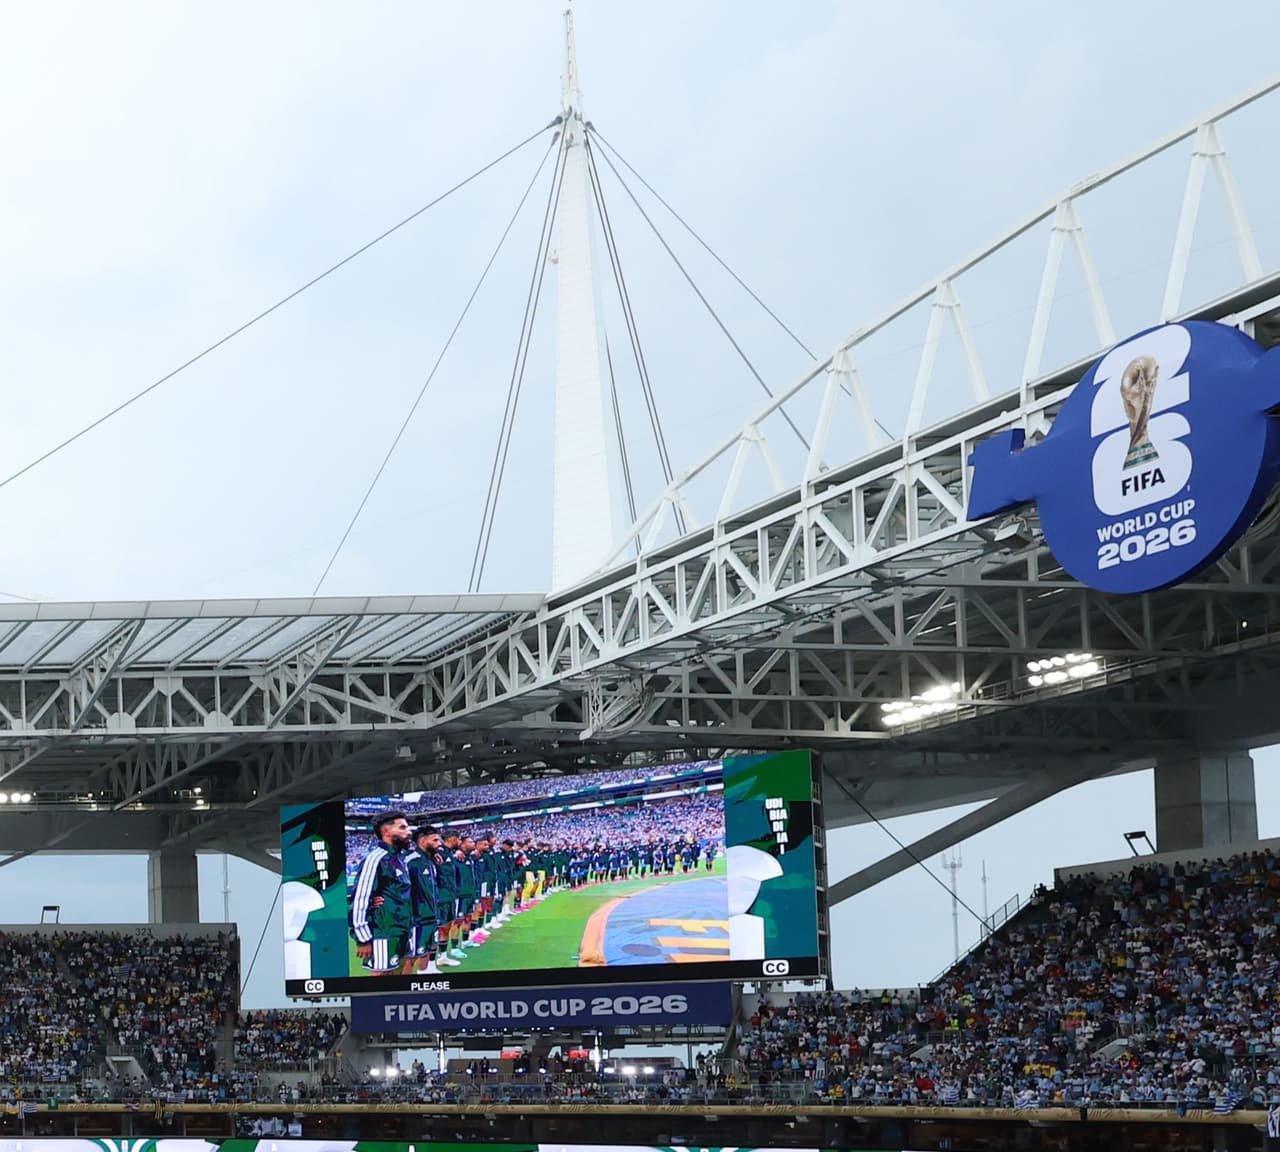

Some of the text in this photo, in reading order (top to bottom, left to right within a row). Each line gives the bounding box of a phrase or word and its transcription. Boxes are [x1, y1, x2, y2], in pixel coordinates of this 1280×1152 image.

[1121, 467, 1165, 496] FIFA
[1096, 498, 1196, 543] WORLD CUP
[1097, 518, 1197, 571] 2026
[765, 961, 787, 974] CC
[306, 981, 322, 991] CC
[411, 981, 450, 991] PLEASE
[383, 994, 688, 1022] FIFA WORLD CUP 2026
